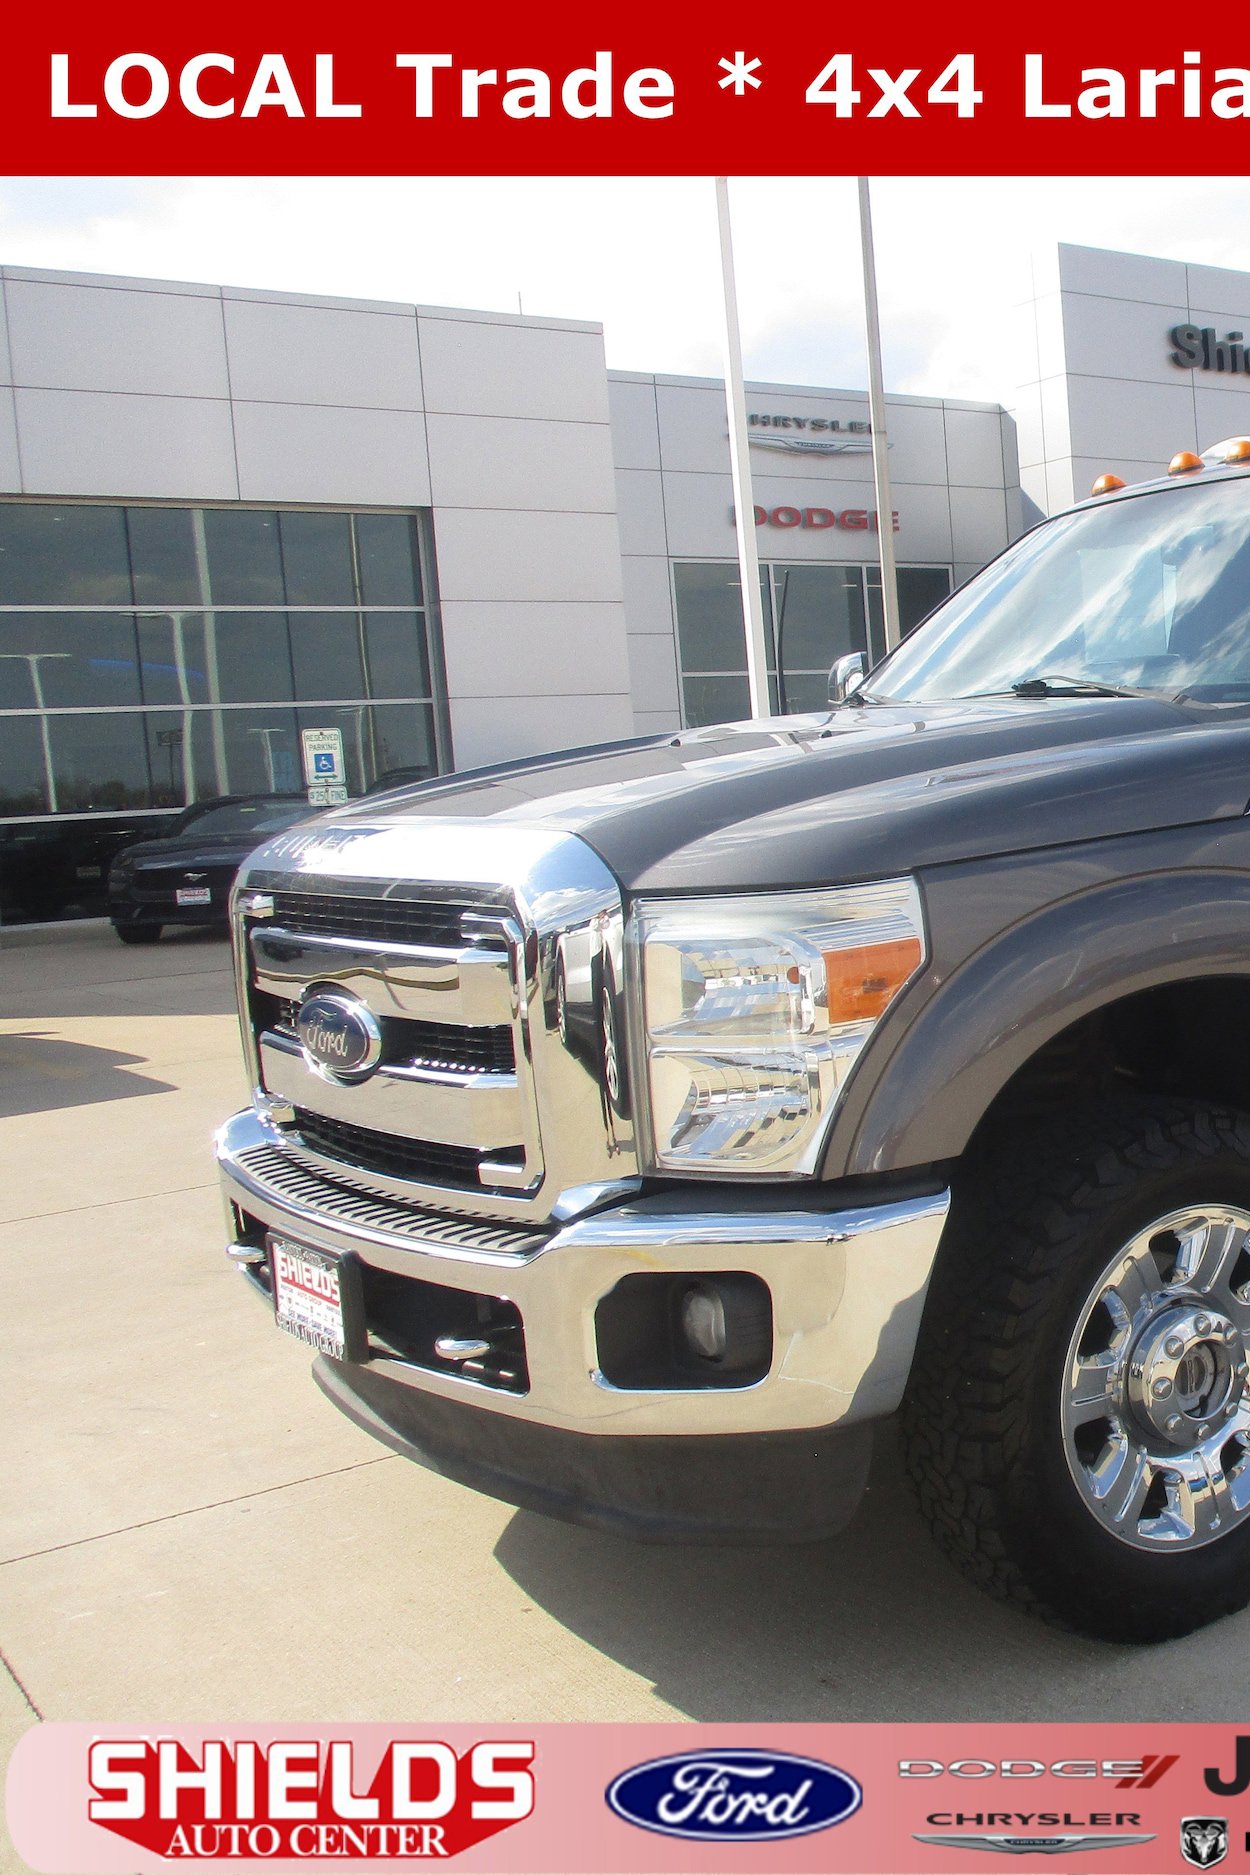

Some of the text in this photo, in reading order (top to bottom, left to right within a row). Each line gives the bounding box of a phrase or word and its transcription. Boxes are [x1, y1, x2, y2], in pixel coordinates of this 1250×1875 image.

[727, 413, 873, 434] HRYSLE
[305, 733, 338, 741] RESERVED
[308, 743, 337, 751] PARKING
[306, 1007, 348, 1057] Ford
[279, 1253, 340, 1303] SHIELDS
